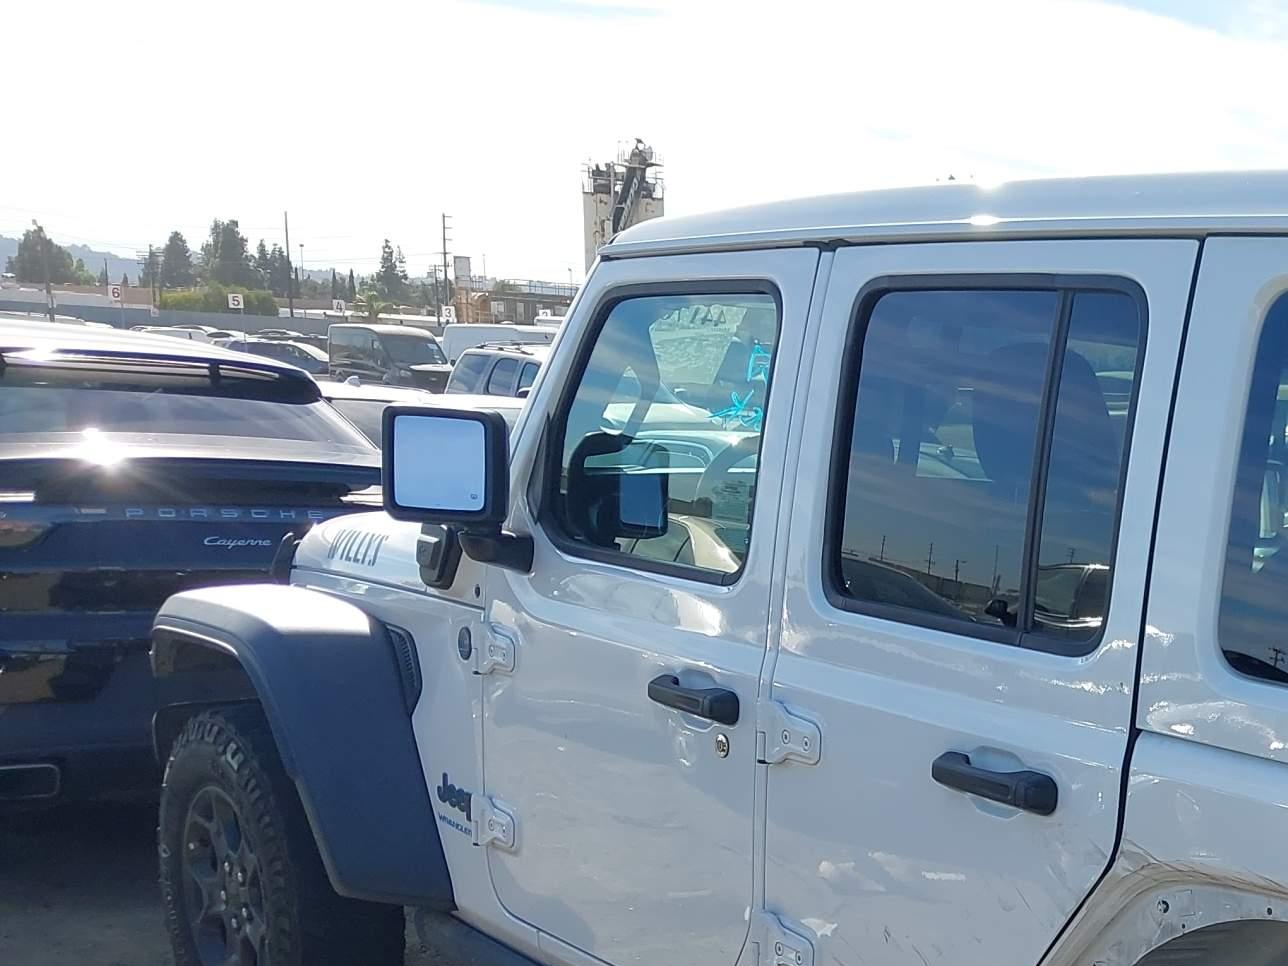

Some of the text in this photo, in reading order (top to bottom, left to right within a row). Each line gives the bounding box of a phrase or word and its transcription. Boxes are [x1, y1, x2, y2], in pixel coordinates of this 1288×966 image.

[111, 287, 120, 299] 6
[231, 295, 241, 306] 5
[334, 300, 343, 313] 4
[443, 307, 451, 318] 3
[125, 508, 324, 520] PORSCHE
[203, 536, 272, 549] Cayenne
[437, 772, 472, 822] Jeep
